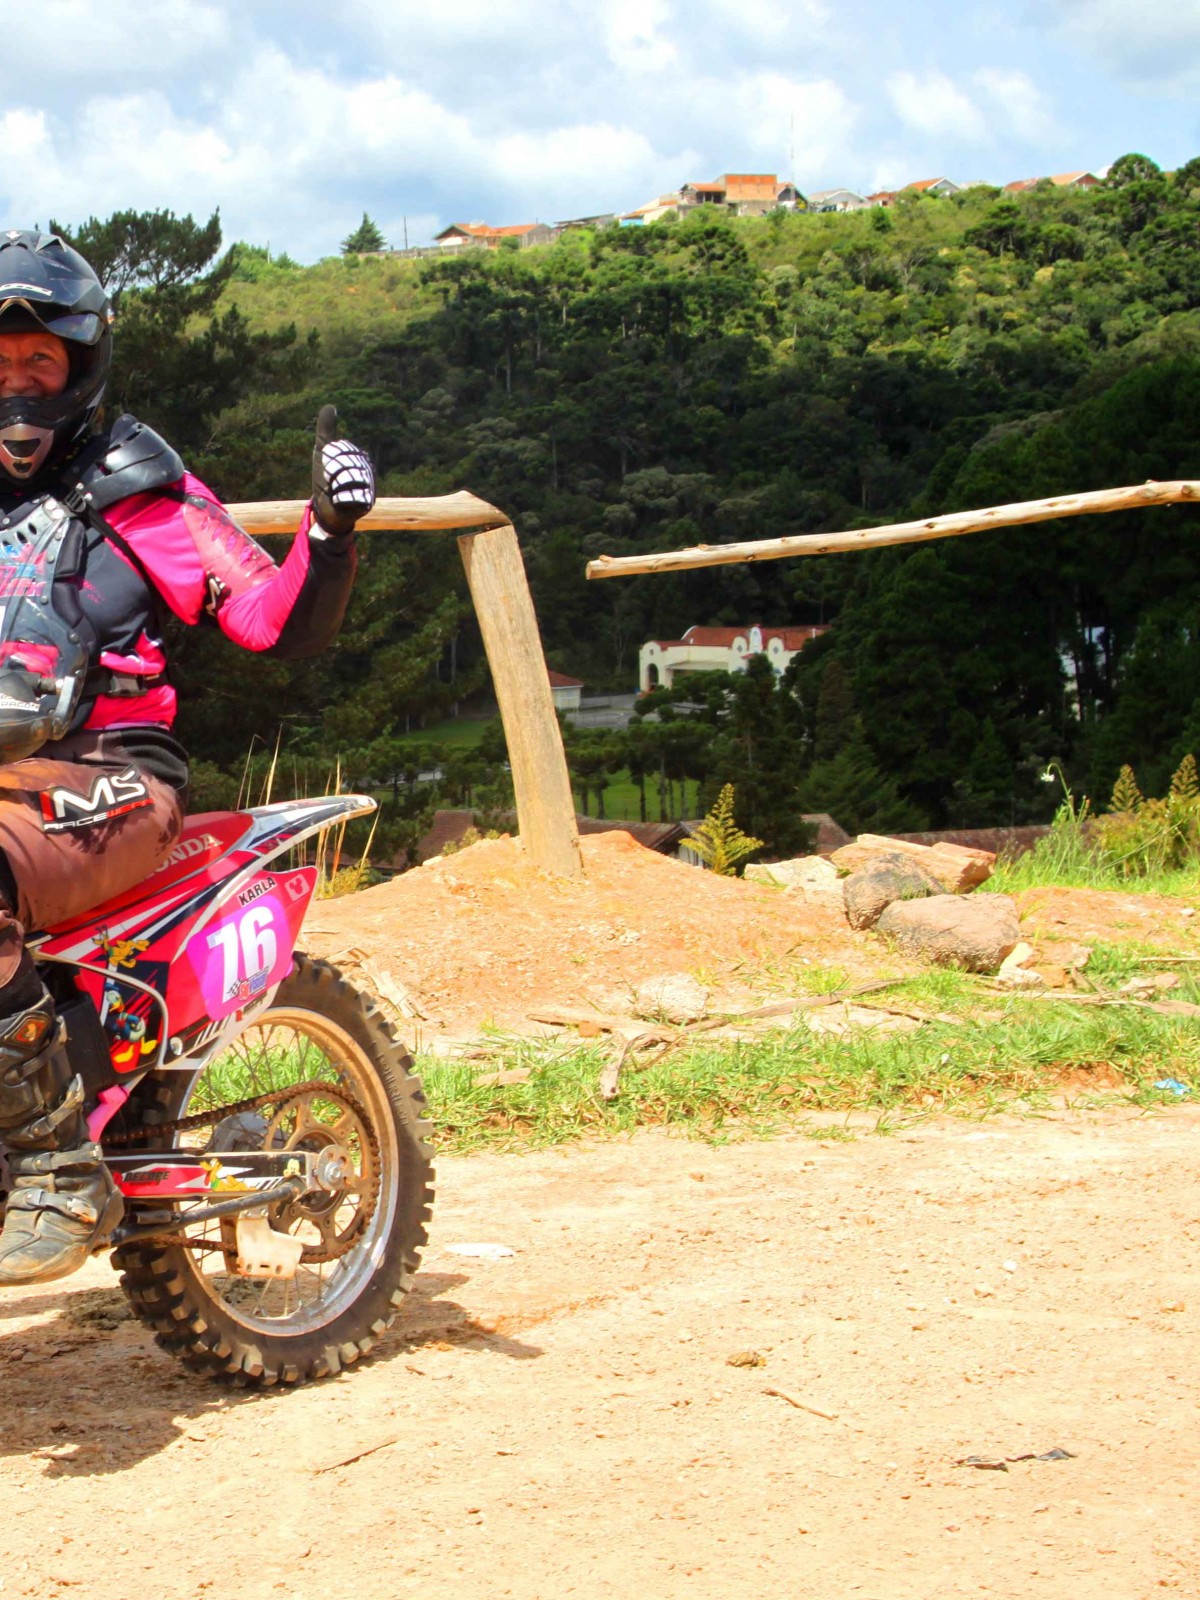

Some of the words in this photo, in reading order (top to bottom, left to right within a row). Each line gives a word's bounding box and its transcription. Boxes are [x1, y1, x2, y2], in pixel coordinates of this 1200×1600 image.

[40, 770, 146, 823] IMS
[238, 876, 277, 906] KARLA
[206, 906, 277, 1004] 76
